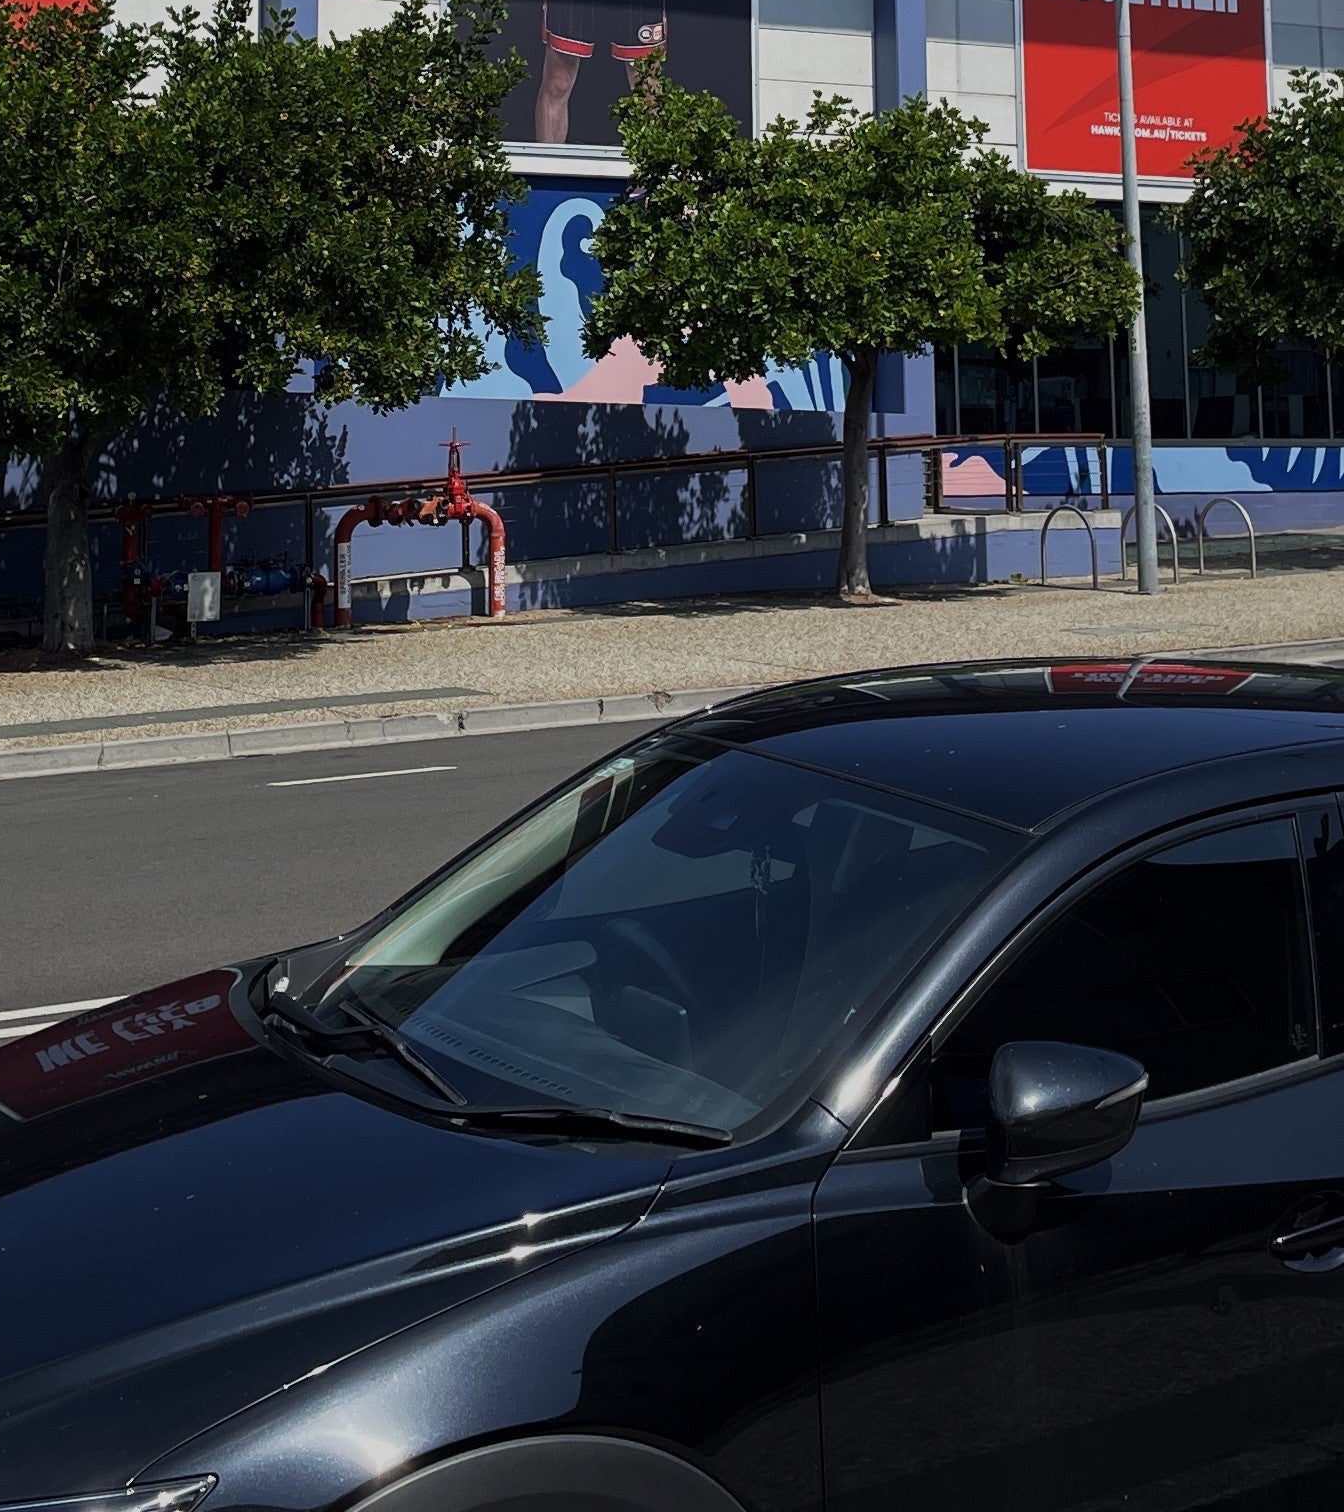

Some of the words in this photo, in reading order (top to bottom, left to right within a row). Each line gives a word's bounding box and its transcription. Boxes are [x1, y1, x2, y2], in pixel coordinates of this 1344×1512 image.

[1104, 112, 1137, 124] TICS
[1140, 115, 1181, 127] AVAILABLE
[1183, 118, 1194, 128] AT
[1090, 124, 1207, 142] HAWKOM.AU/TICKETS
